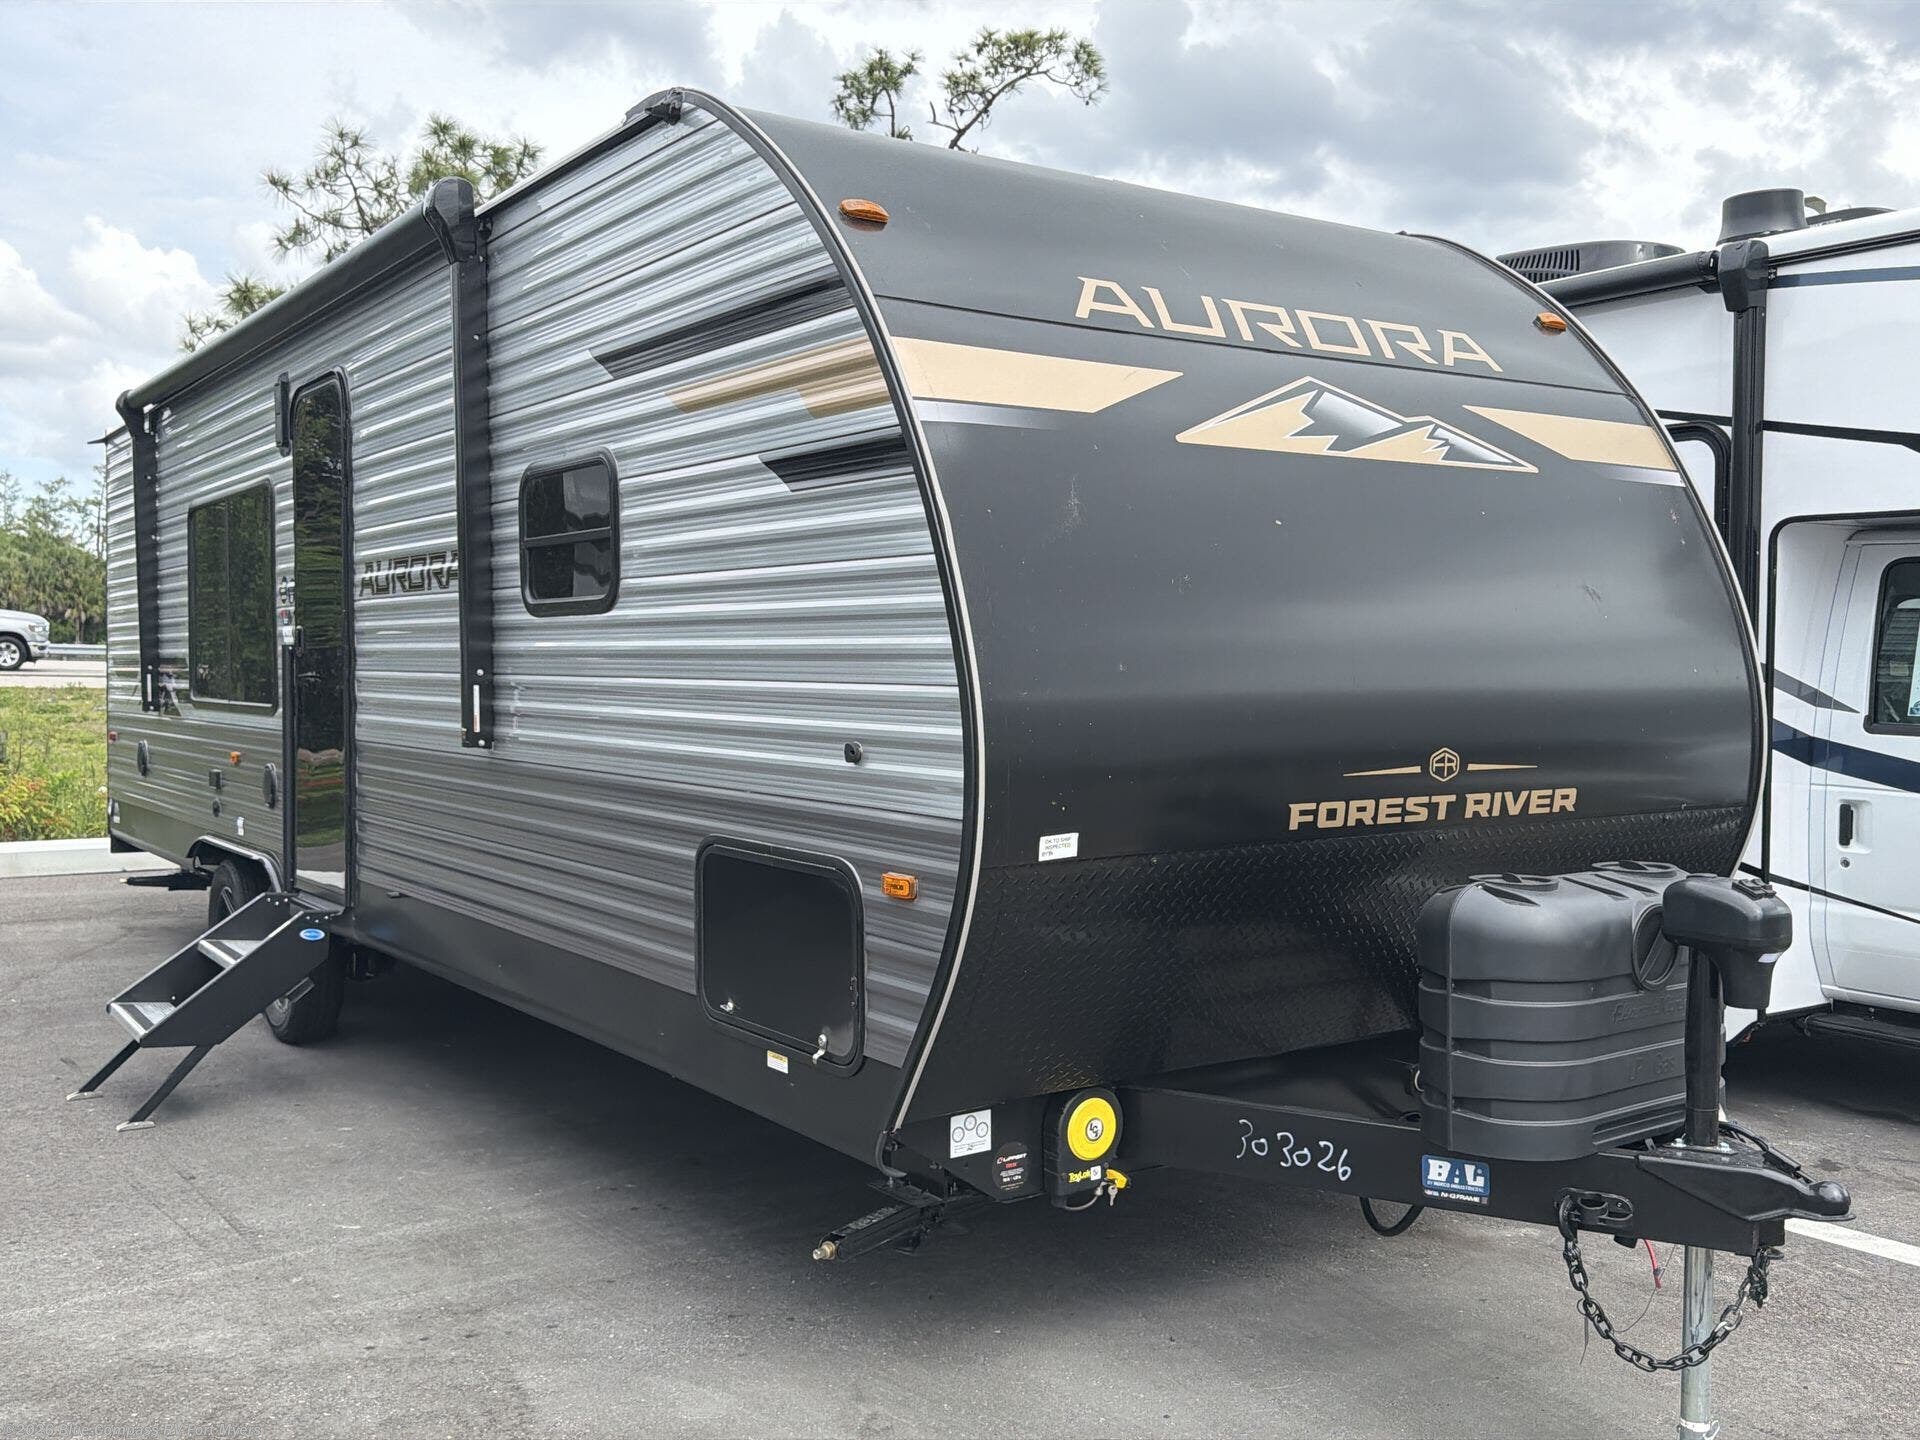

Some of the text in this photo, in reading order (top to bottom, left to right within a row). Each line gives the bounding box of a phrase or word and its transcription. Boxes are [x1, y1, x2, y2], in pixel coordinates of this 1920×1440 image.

[1075, 275, 1504, 373] AURORA
[1288, 787, 1578, 831] FOREST RIVER
